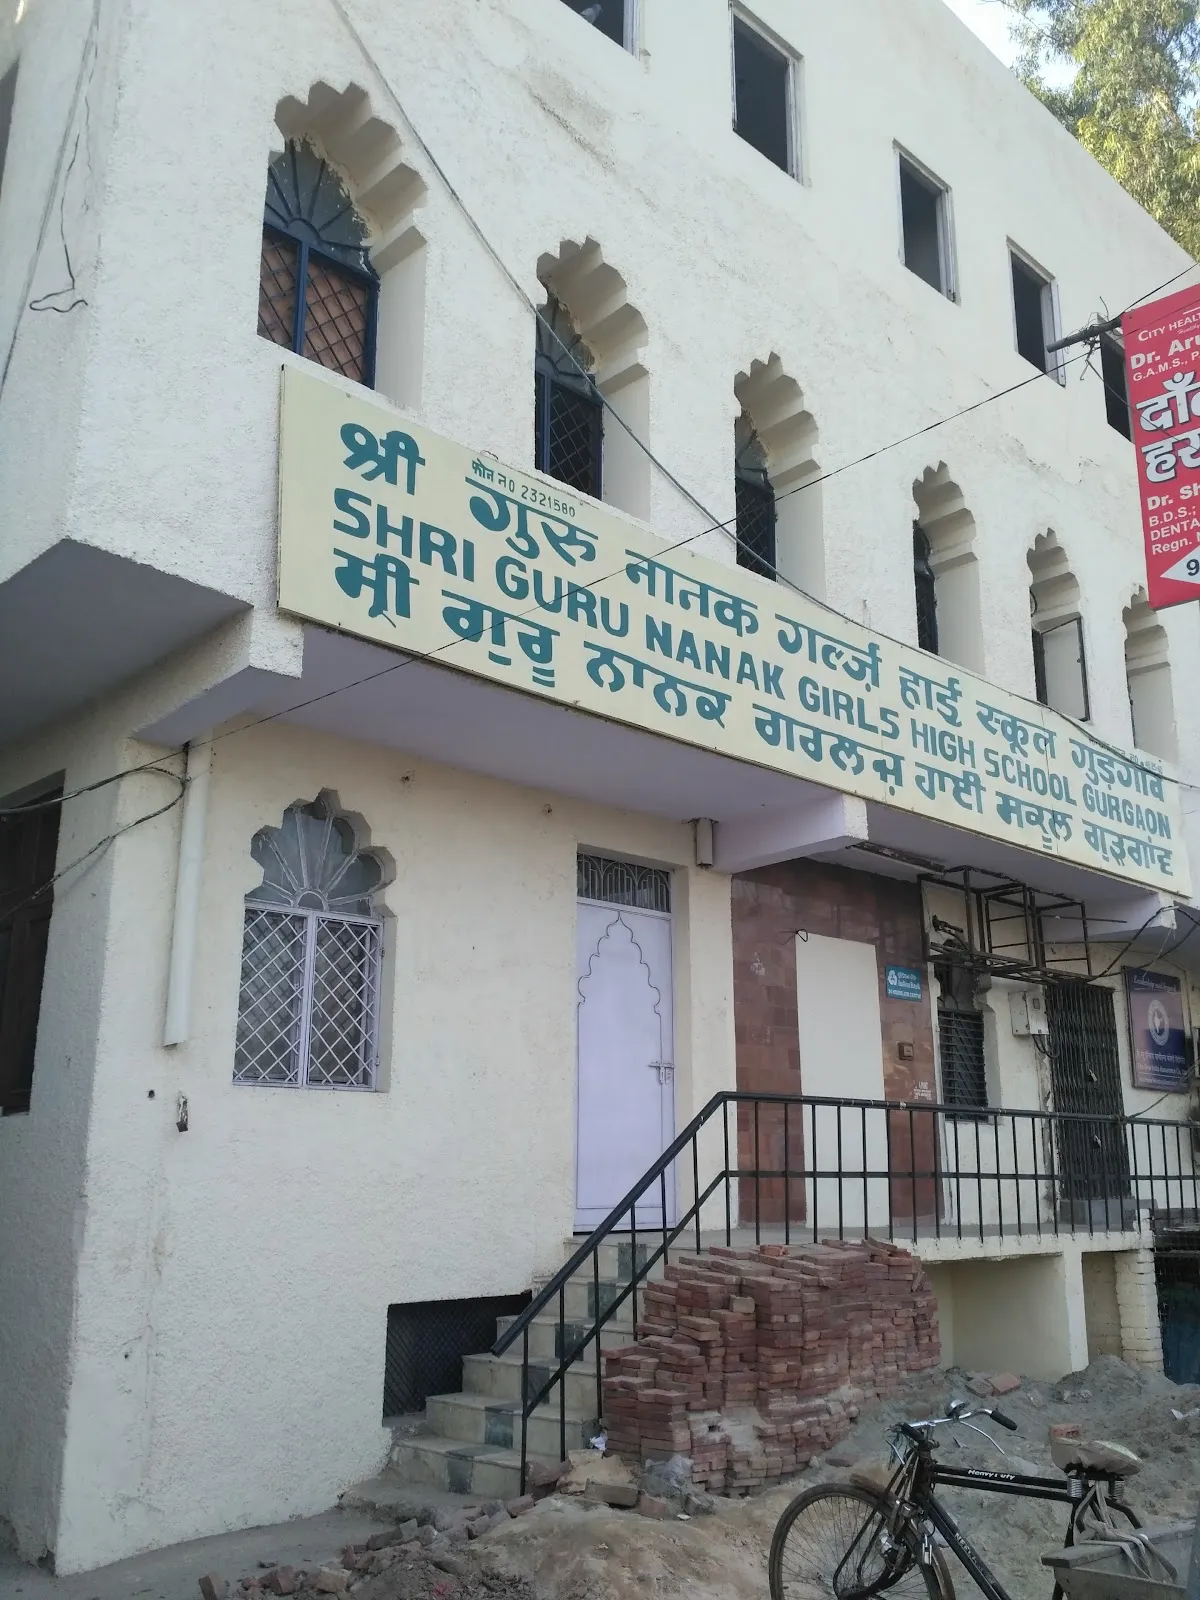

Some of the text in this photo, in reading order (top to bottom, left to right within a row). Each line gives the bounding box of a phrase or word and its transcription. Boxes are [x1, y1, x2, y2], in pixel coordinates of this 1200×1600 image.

[1130, 351, 1160, 370] Dr.
[520, 484, 577, 518] 2321580
[1147, 494, 1174, 511] Dr.
[1152, 537, 1192, 556] Regn.
[339, 422, 426, 496] श्री
[464, 475, 599, 568] गुरु
[624, 548, 759, 638] नानक
[898, 665, 963, 728] हाई
[975, 699, 1057, 759] स्कूल
[333, 487, 475, 583] SHRI
[495, 555, 630, 638] GURU
[645, 614, 786, 701] NANAK
[798, 675, 901, 740] GIRLS
[910, 717, 976, 769] HIGH
[983, 747, 1078, 807] SCHOOL
[1081, 782, 1172, 841] GURGAON
[333, 547, 420, 628] ਸ੍ਰੀ
[441, 588, 561, 688] ਗੁਰੂ
[583, 640, 733, 730] ਨਾਨਕ
[914, 760, 987, 815] ਹਾਈ
[995, 790, 1073, 850] ਸਕੂਲ
